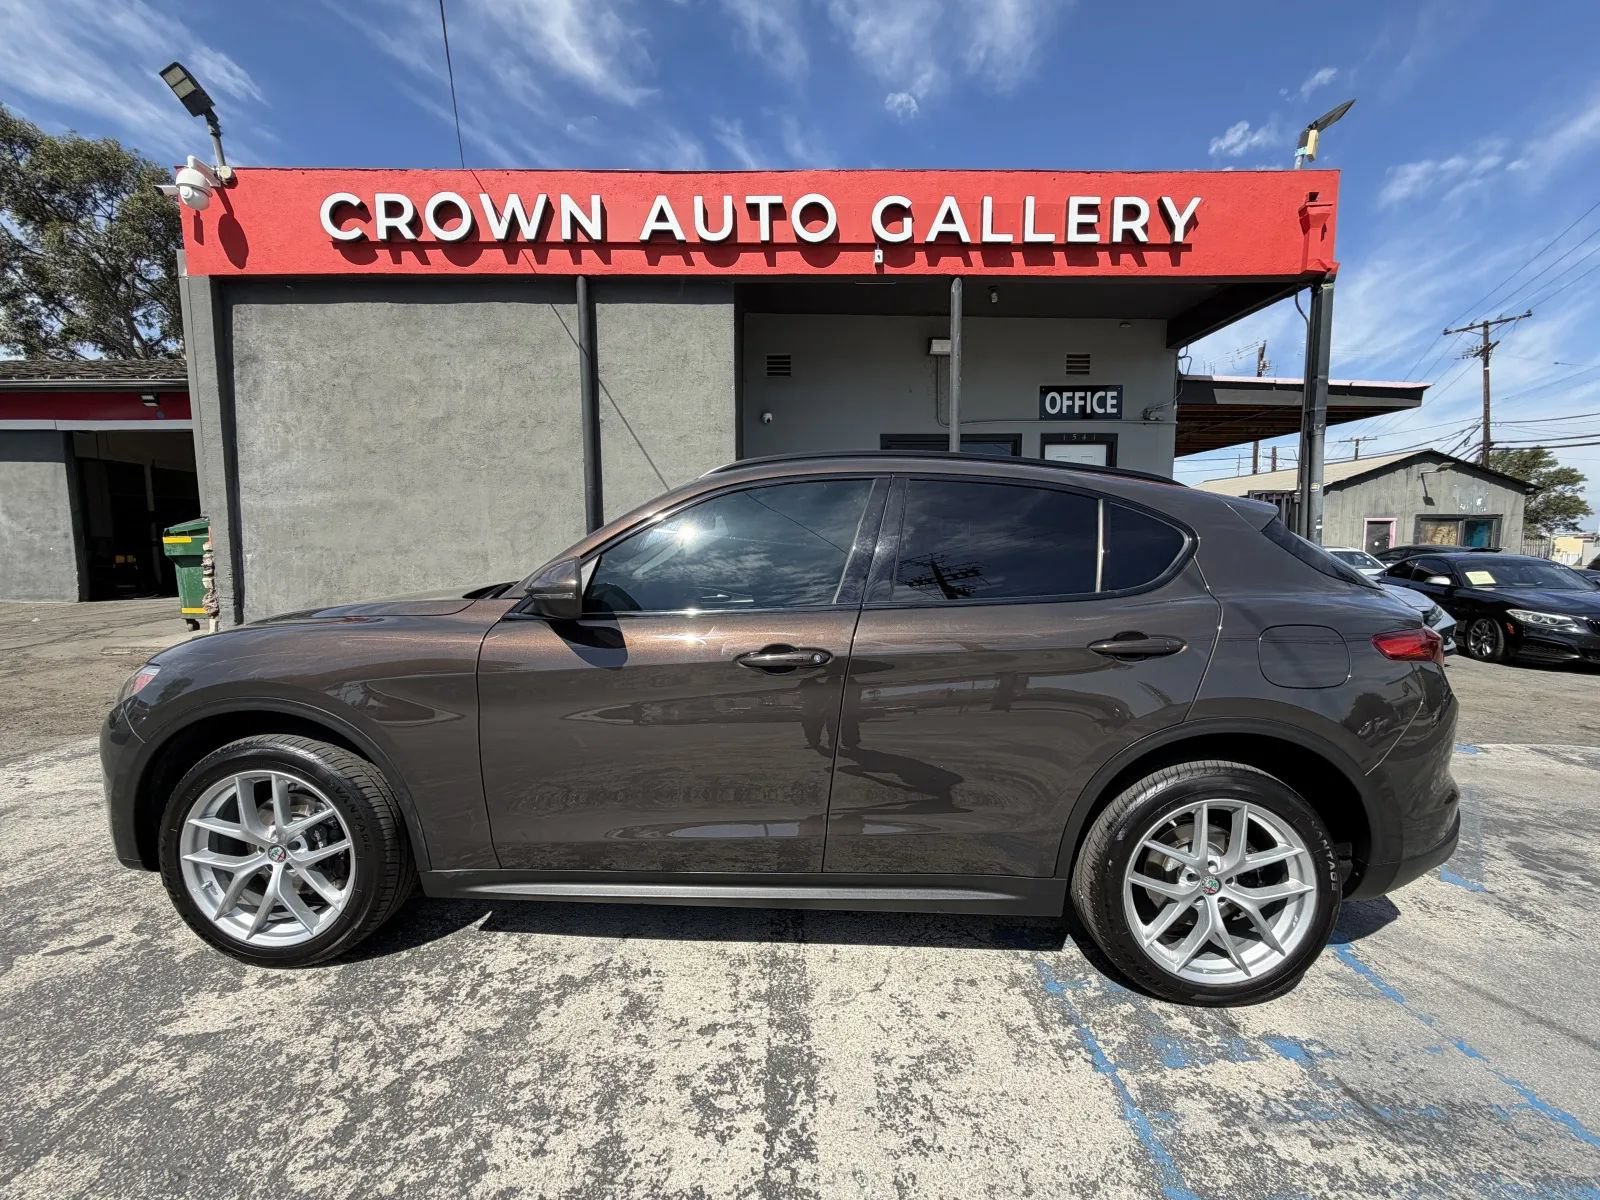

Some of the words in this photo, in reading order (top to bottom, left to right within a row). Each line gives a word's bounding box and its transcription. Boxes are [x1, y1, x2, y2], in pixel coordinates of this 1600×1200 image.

[319, 191, 602, 243] CROWN
[639, 193, 837, 243] AUTO
[871, 194, 1202, 244] GALLERY
[1044, 391, 1118, 415] OFFICE
[1063, 432, 1096, 441] 1541
